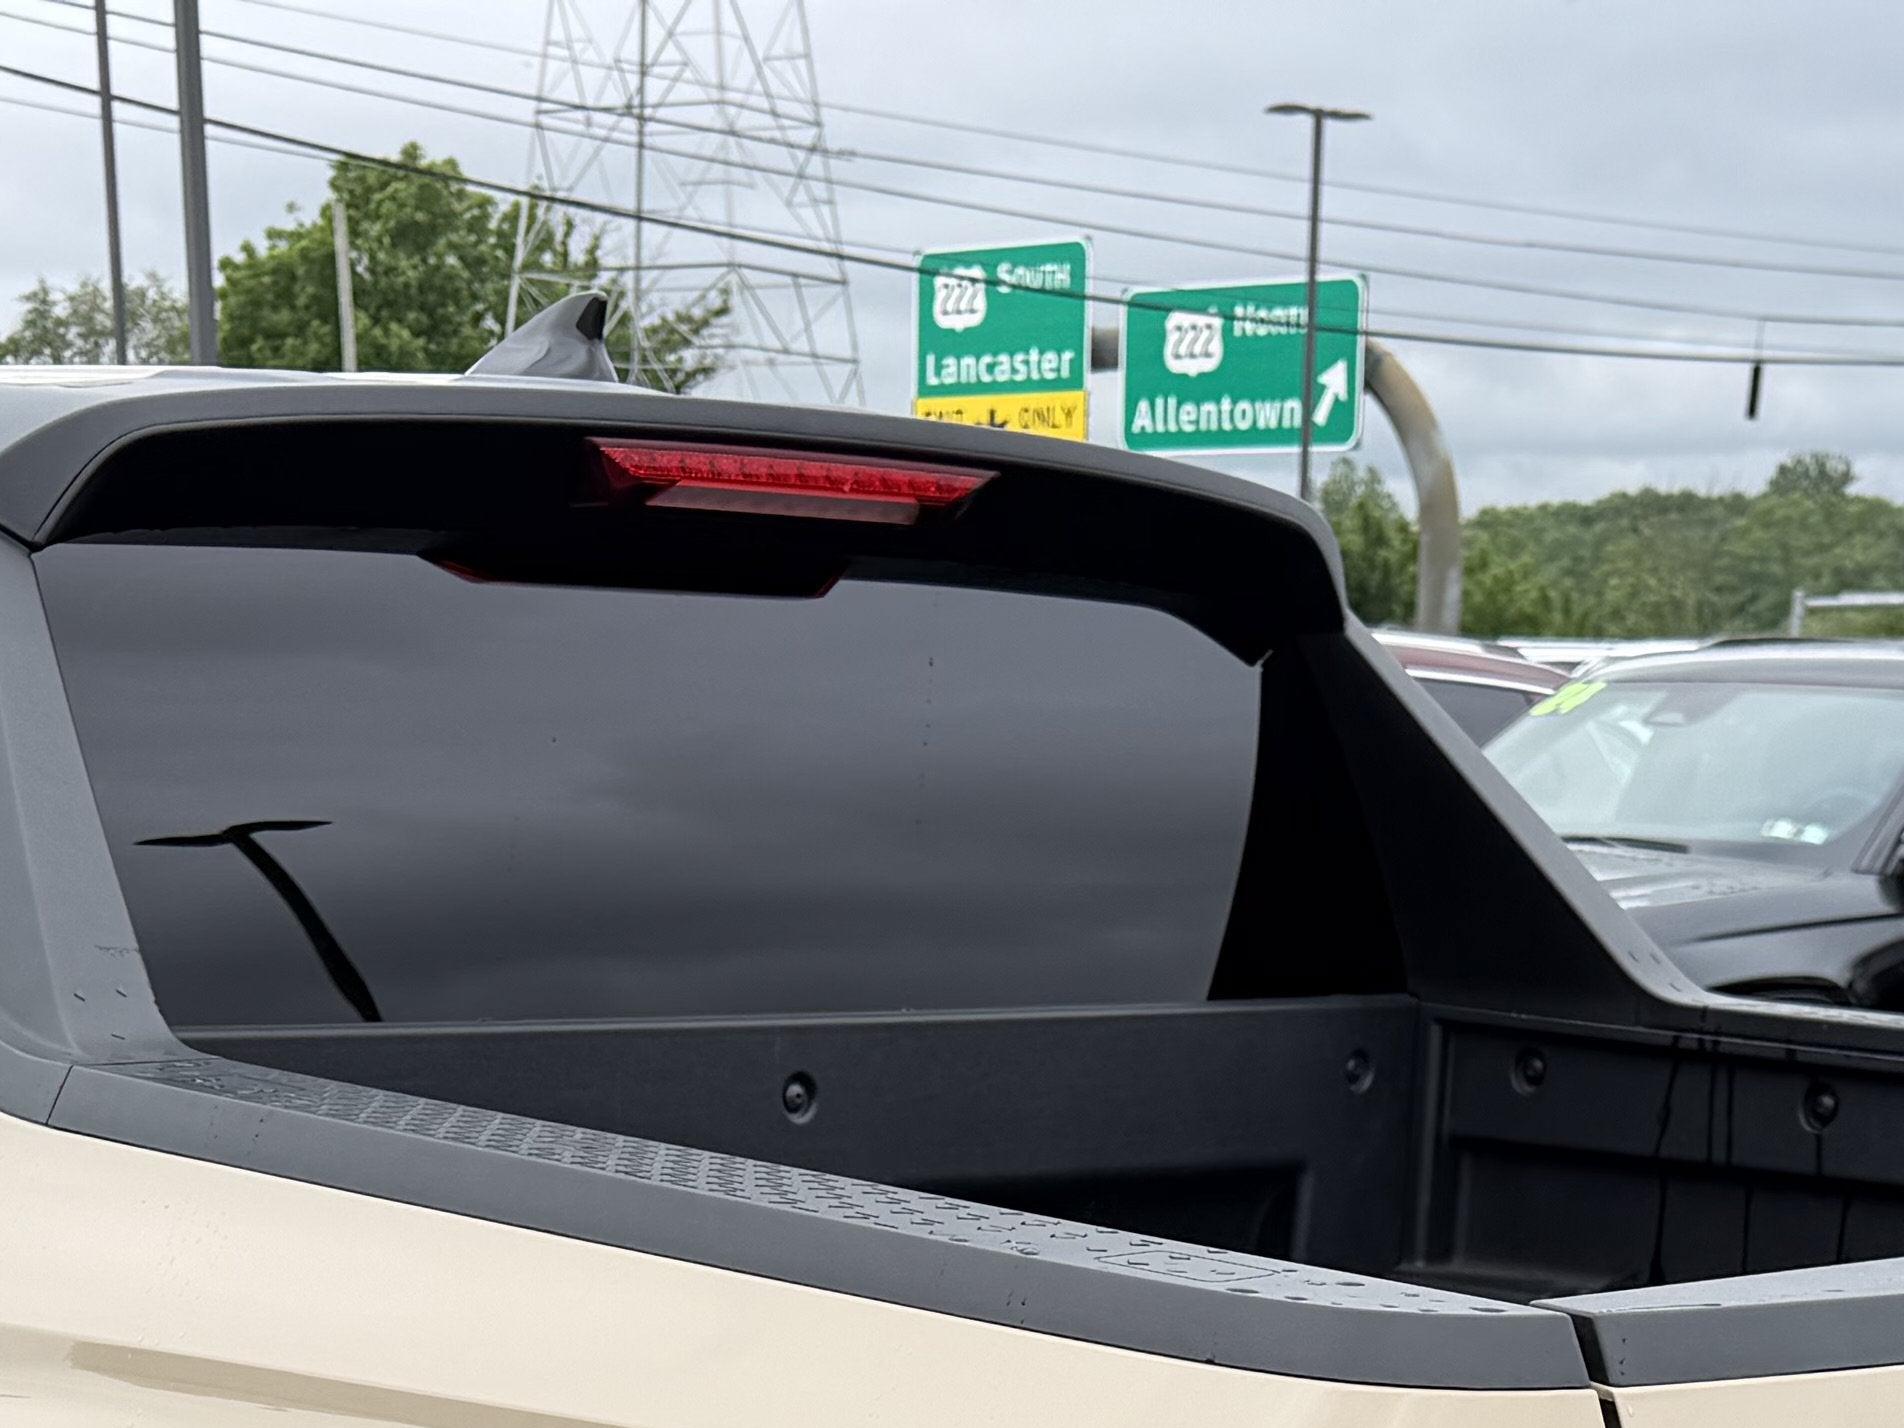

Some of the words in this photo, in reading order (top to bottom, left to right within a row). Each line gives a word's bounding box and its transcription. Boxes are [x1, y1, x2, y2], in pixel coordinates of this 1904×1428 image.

[941, 283, 979, 316] 222
[1171, 323, 1216, 360] 222
[926, 347, 1075, 386] Lancaster
[1131, 396, 1303, 433] Allentown
